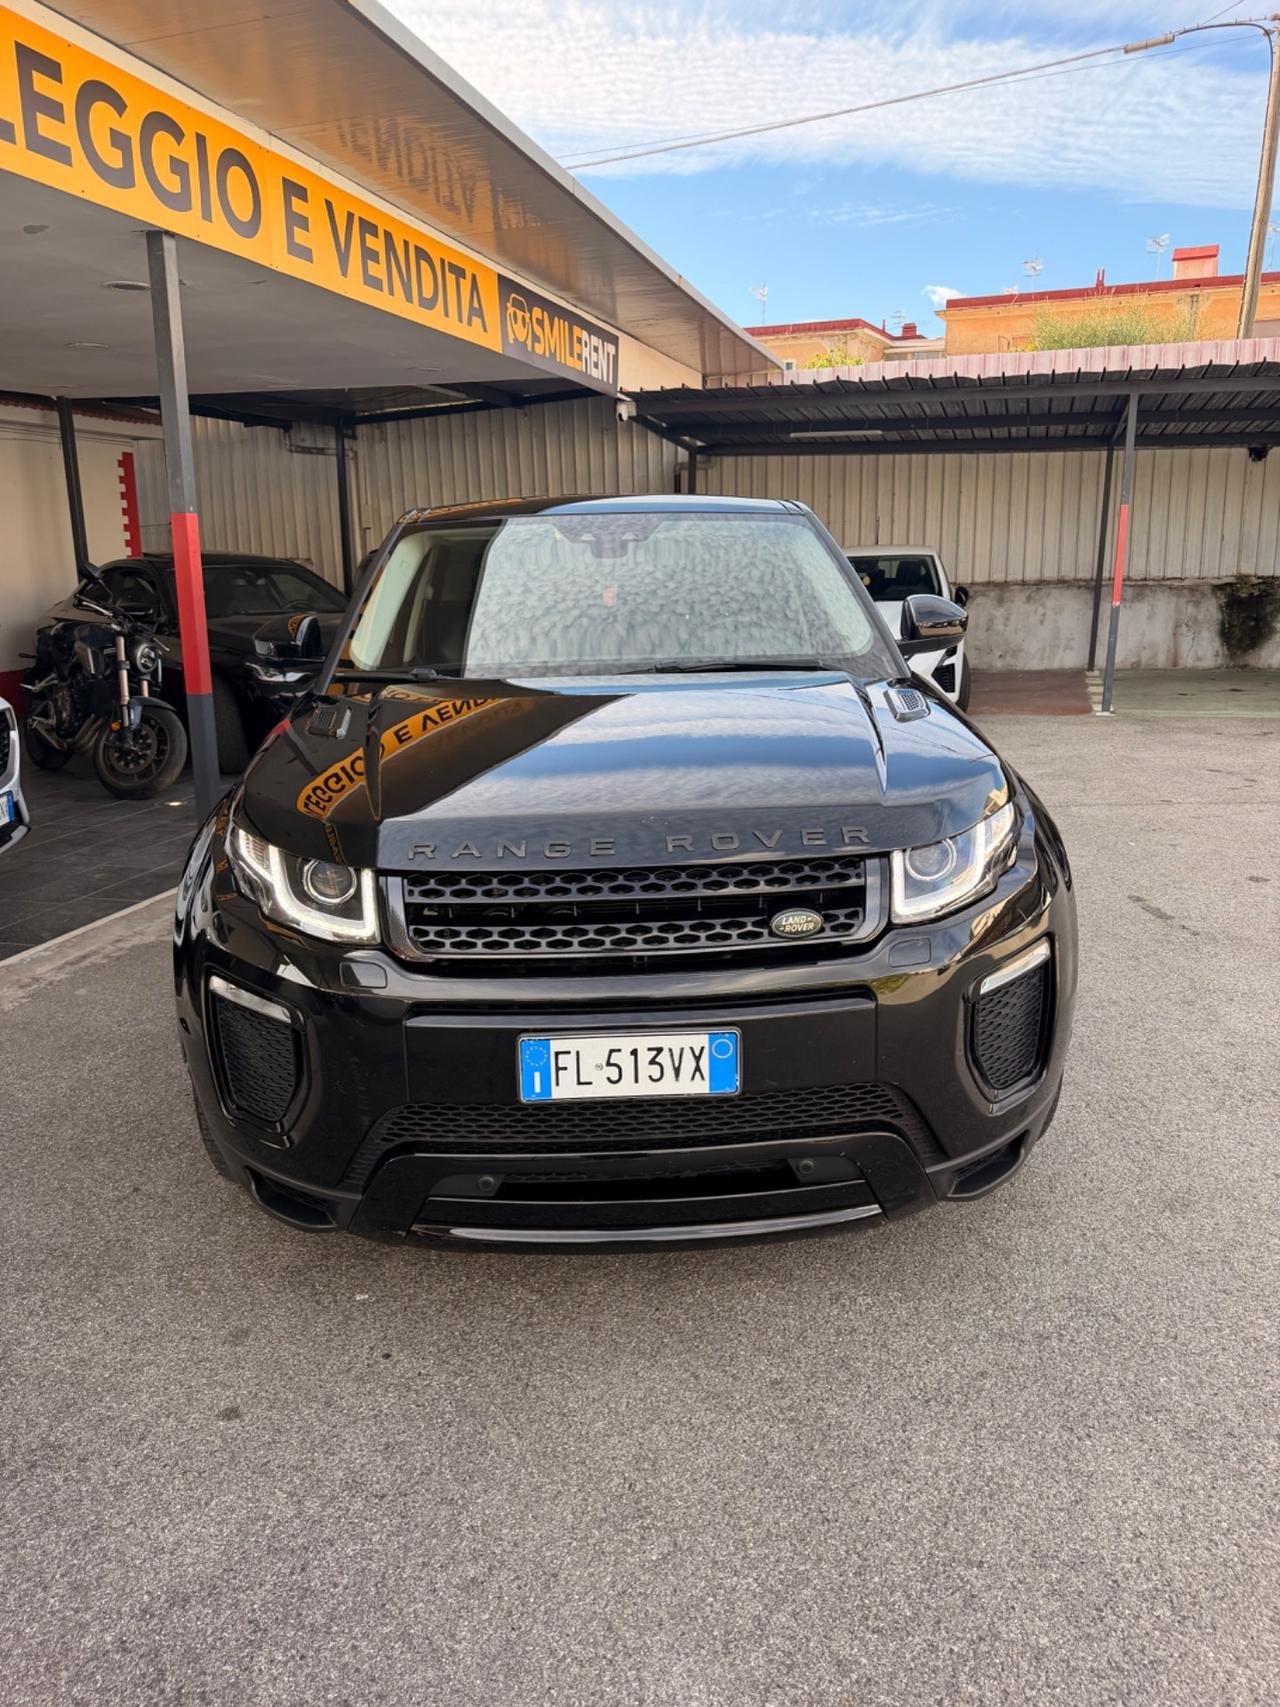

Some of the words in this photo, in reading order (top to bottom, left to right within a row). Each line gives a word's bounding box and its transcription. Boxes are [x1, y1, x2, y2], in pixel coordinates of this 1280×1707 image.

[0, 40, 261, 239] EGGIO
[282, 176, 314, 264] E
[324, 198, 488, 333] VENDITA
[408, 838, 616, 860] RANGE
[666, 826, 870, 853] ROVER
[533, 1071, 541, 1093] I
